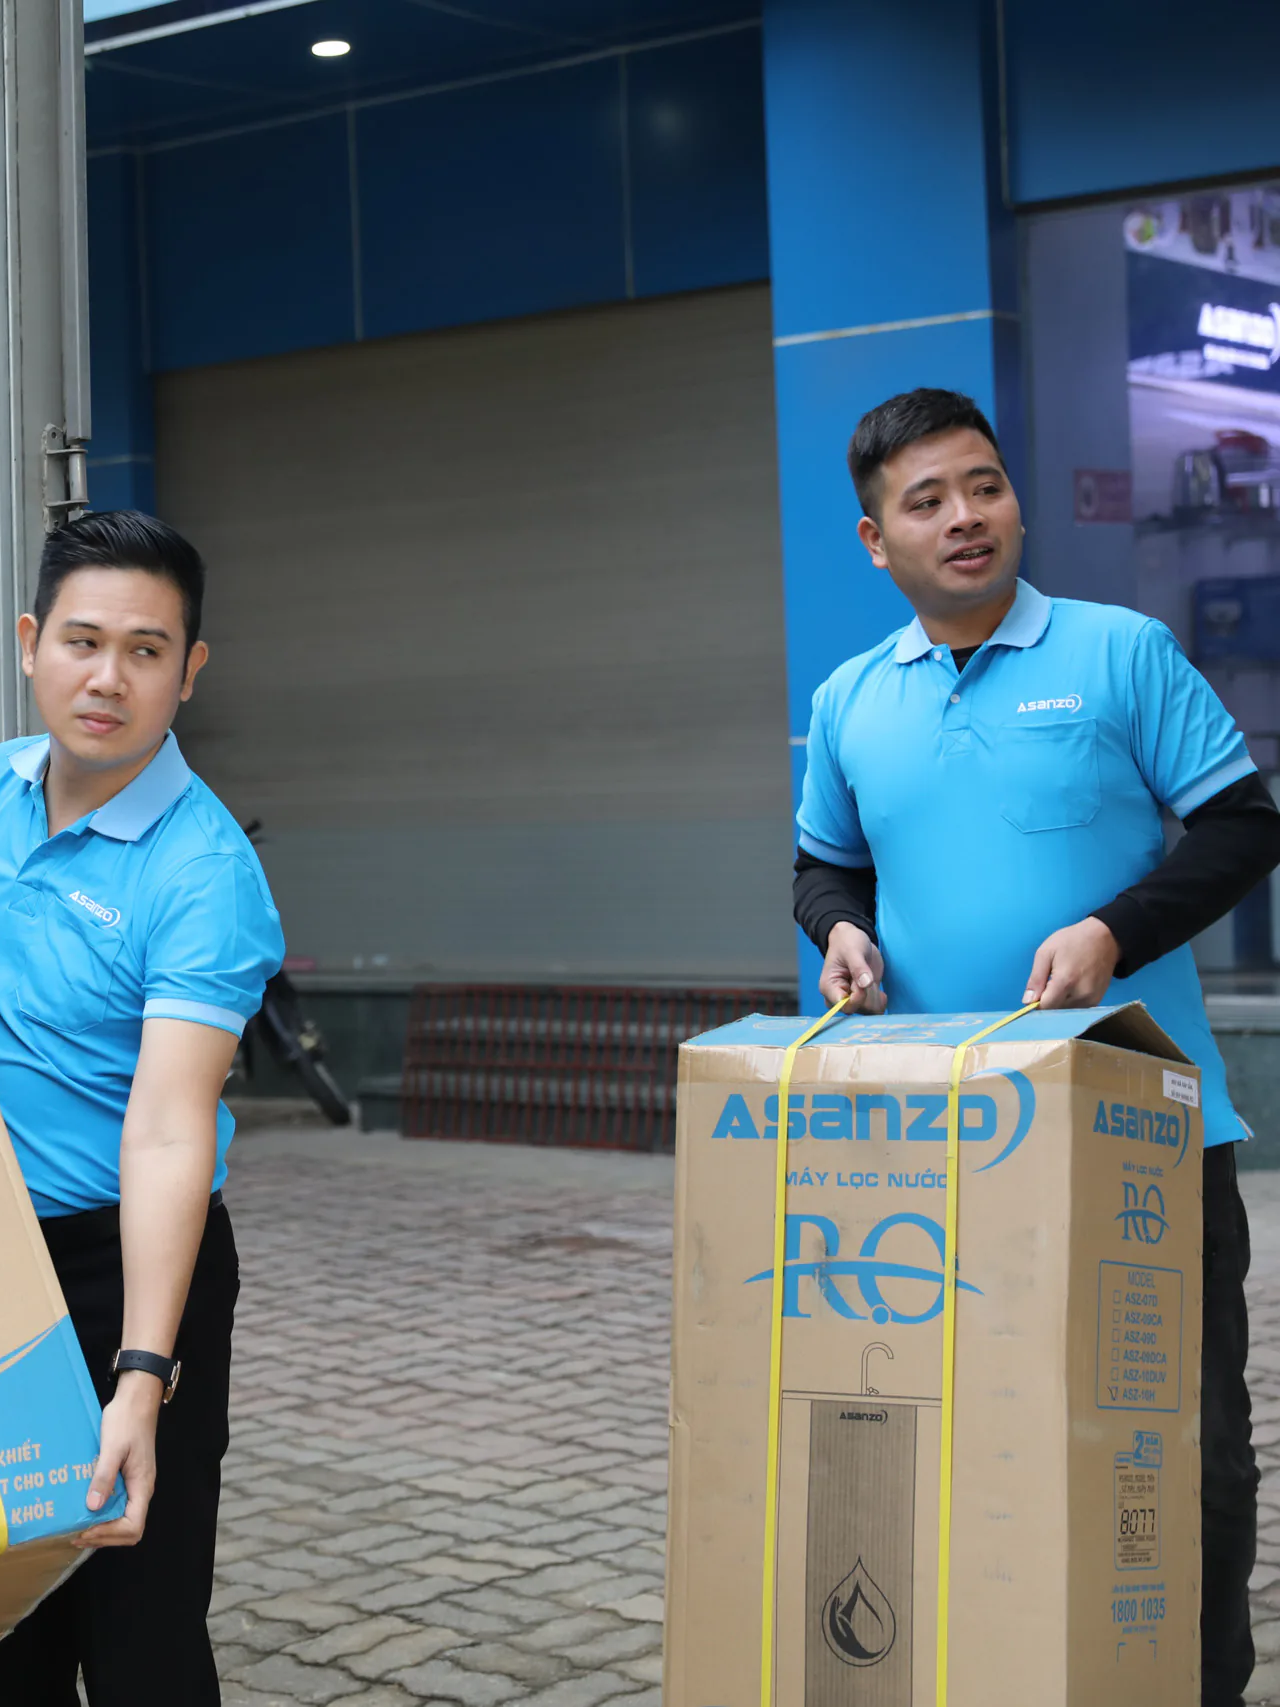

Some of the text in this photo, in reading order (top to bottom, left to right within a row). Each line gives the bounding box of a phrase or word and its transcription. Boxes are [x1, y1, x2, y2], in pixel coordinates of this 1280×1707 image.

[1017, 699, 1075, 712] Asanzo
[711, 1093, 998, 1141] Asanzo
[1093, 1100, 1180, 1148] Asanzo
[786, 1167, 829, 1186] MÁY
[837, 1172, 878, 1189] LỌC
[1128, 1271, 1156, 1288] MODEL
[839, 1412, 882, 1421] Asanzo
[14, 1473, 44, 1492] CHO
[49, 1464, 68, 1485] CƠ
[11, 1498, 54, 1525] KHỎE
[1120, 1509, 1155, 1534] 8077
[1111, 1597, 1165, 1623] 1800 1035
